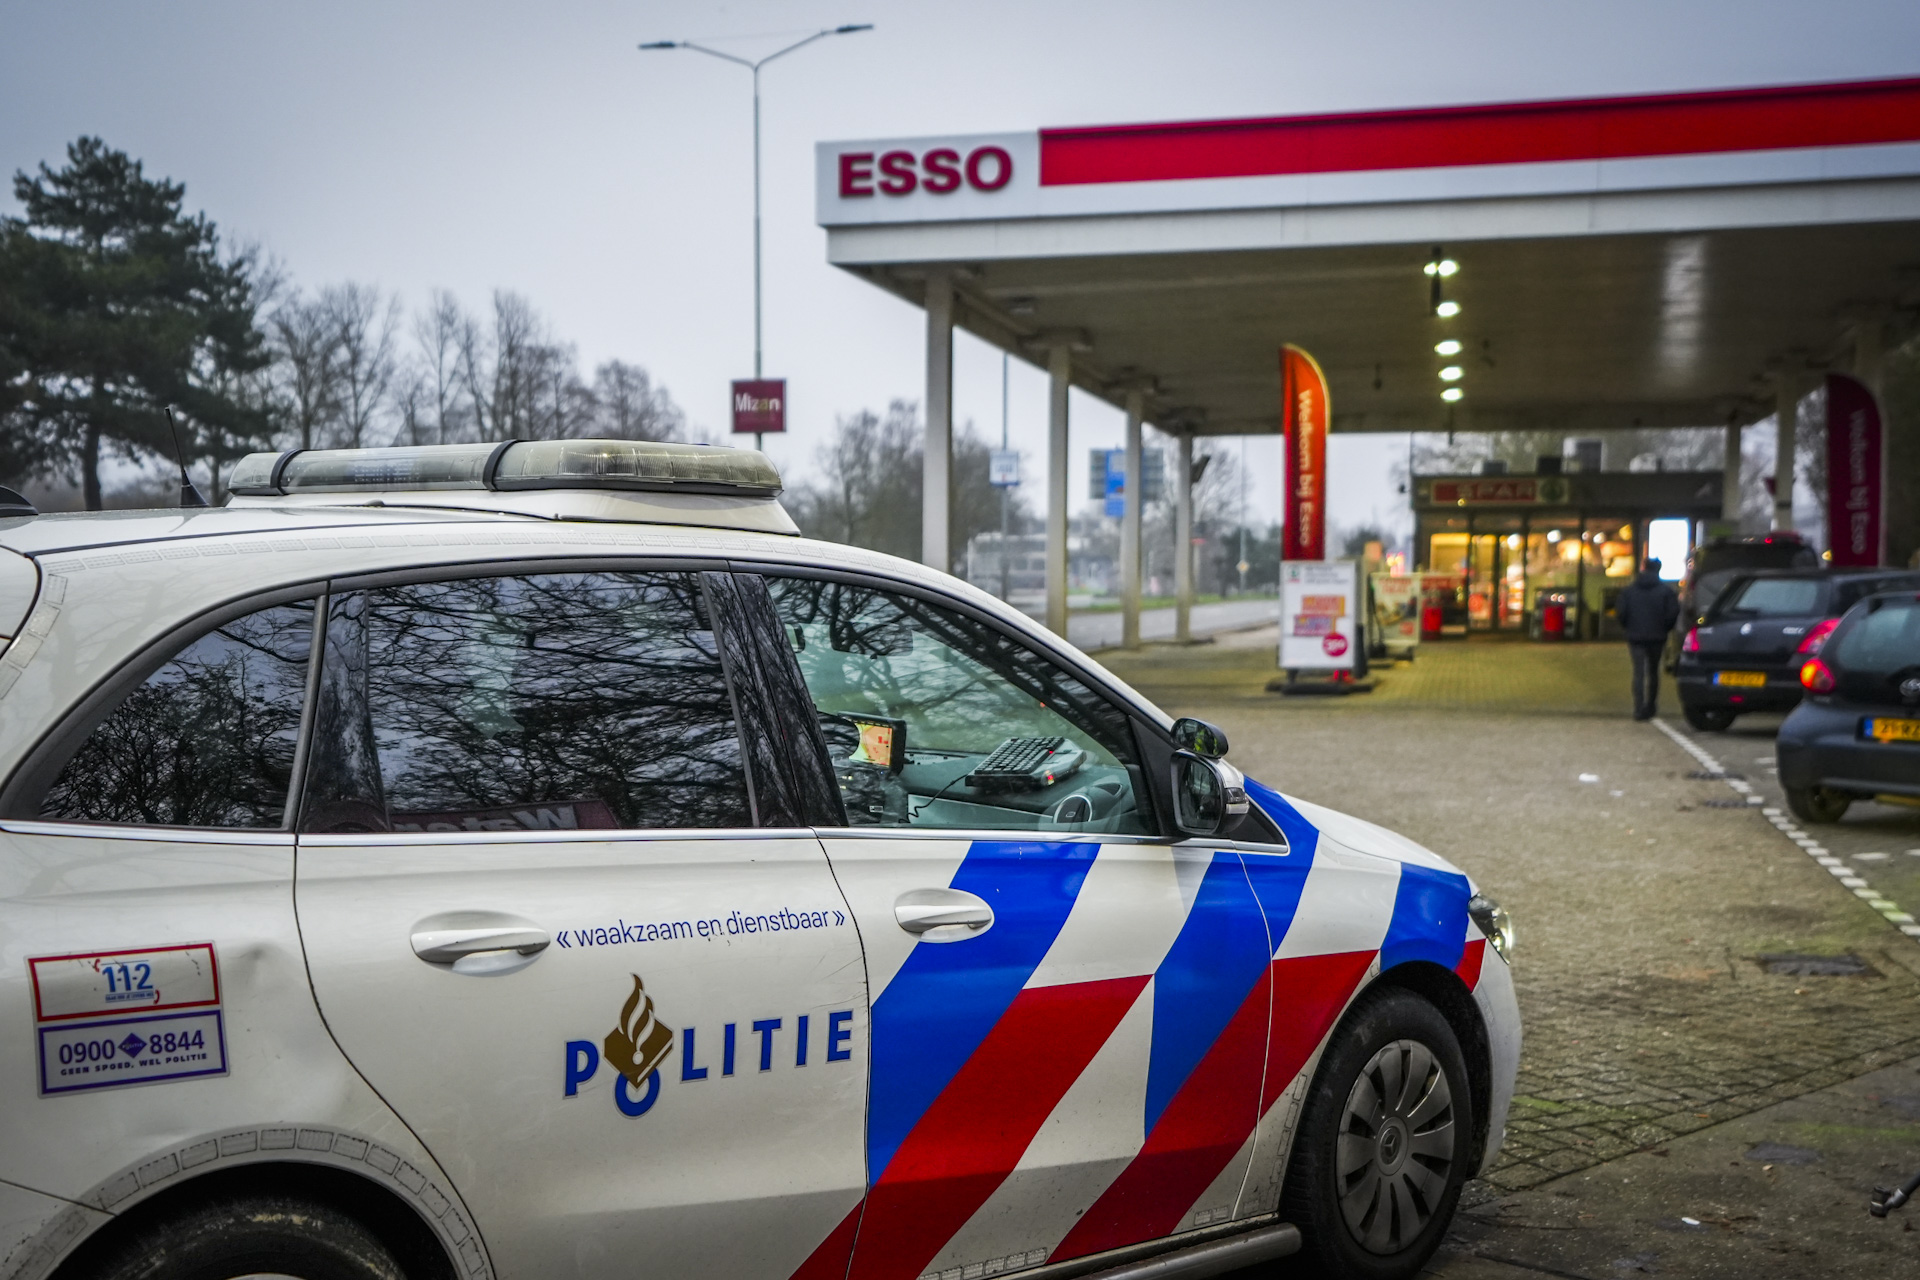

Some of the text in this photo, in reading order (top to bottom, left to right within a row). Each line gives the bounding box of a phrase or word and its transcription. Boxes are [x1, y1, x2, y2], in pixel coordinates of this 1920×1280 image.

[838, 145, 1013, 198] ESSO
[735, 392, 781, 412] Mizan
[1295, 389, 1315, 547] Welkom bij Esso
[1457, 481, 1534, 501] SPAR
[698, 918, 723, 937] en
[59, 1039, 116, 1065] 0900
[150, 1030, 205, 1055] 8844
[60, 1066, 90, 1076] GEEN
[139, 1058, 161, 1067] WEL
[165, 1053, 207, 1064] POLITIE
[563, 1009, 854, 1118] POLITIE
